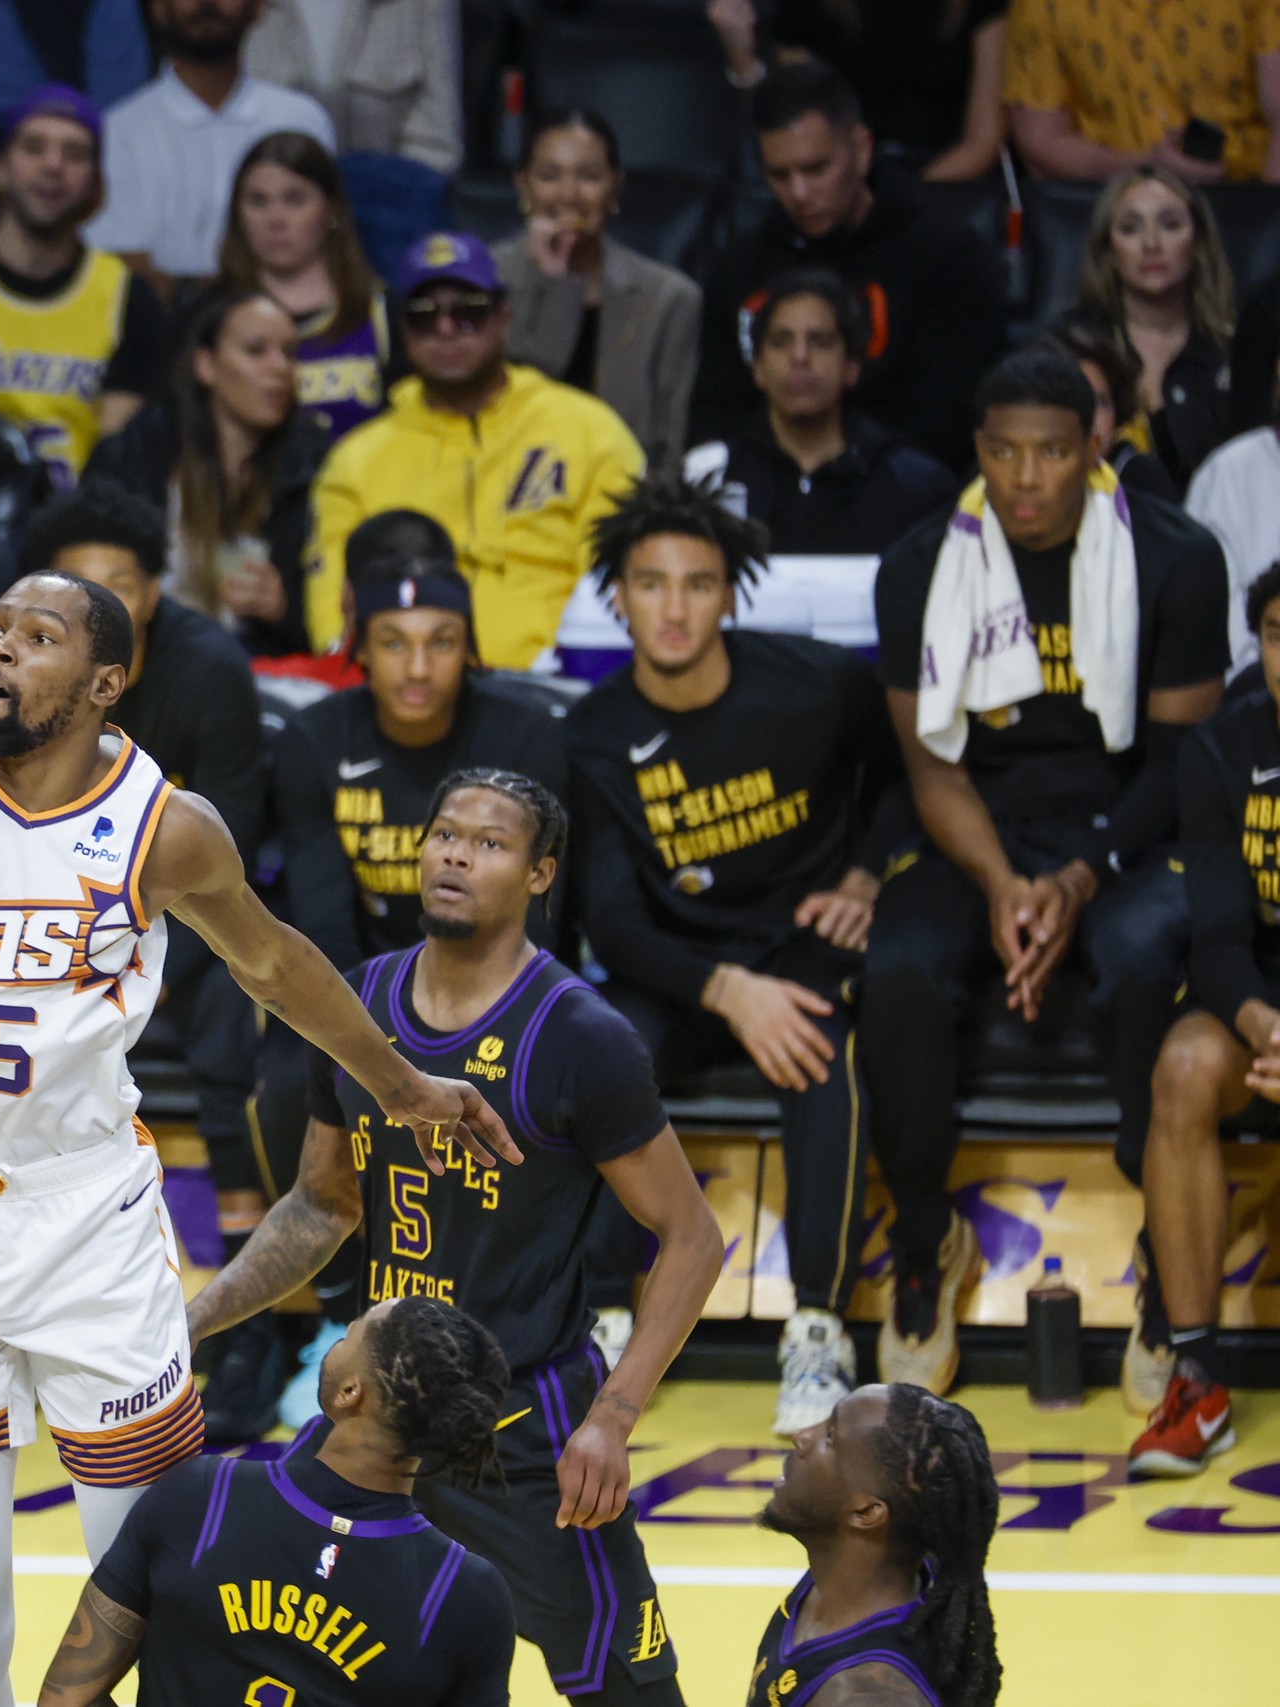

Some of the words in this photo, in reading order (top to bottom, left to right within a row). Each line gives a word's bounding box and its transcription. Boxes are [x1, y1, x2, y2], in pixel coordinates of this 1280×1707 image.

[334, 785, 384, 824] NBA
[635, 759, 688, 801] NBA
[644, 767, 775, 836] IN-SEASON
[73, 841, 121, 863] PayPal
[655, 788, 809, 870] TOURNAMENT
[464, 1058, 507, 1082] bibigo
[351, 1114, 372, 1172] OS
[389, 1164, 432, 1261] 5
[99, 1350, 183, 1425] PHOENIX
[218, 1579, 388, 1682] RUSSELL
